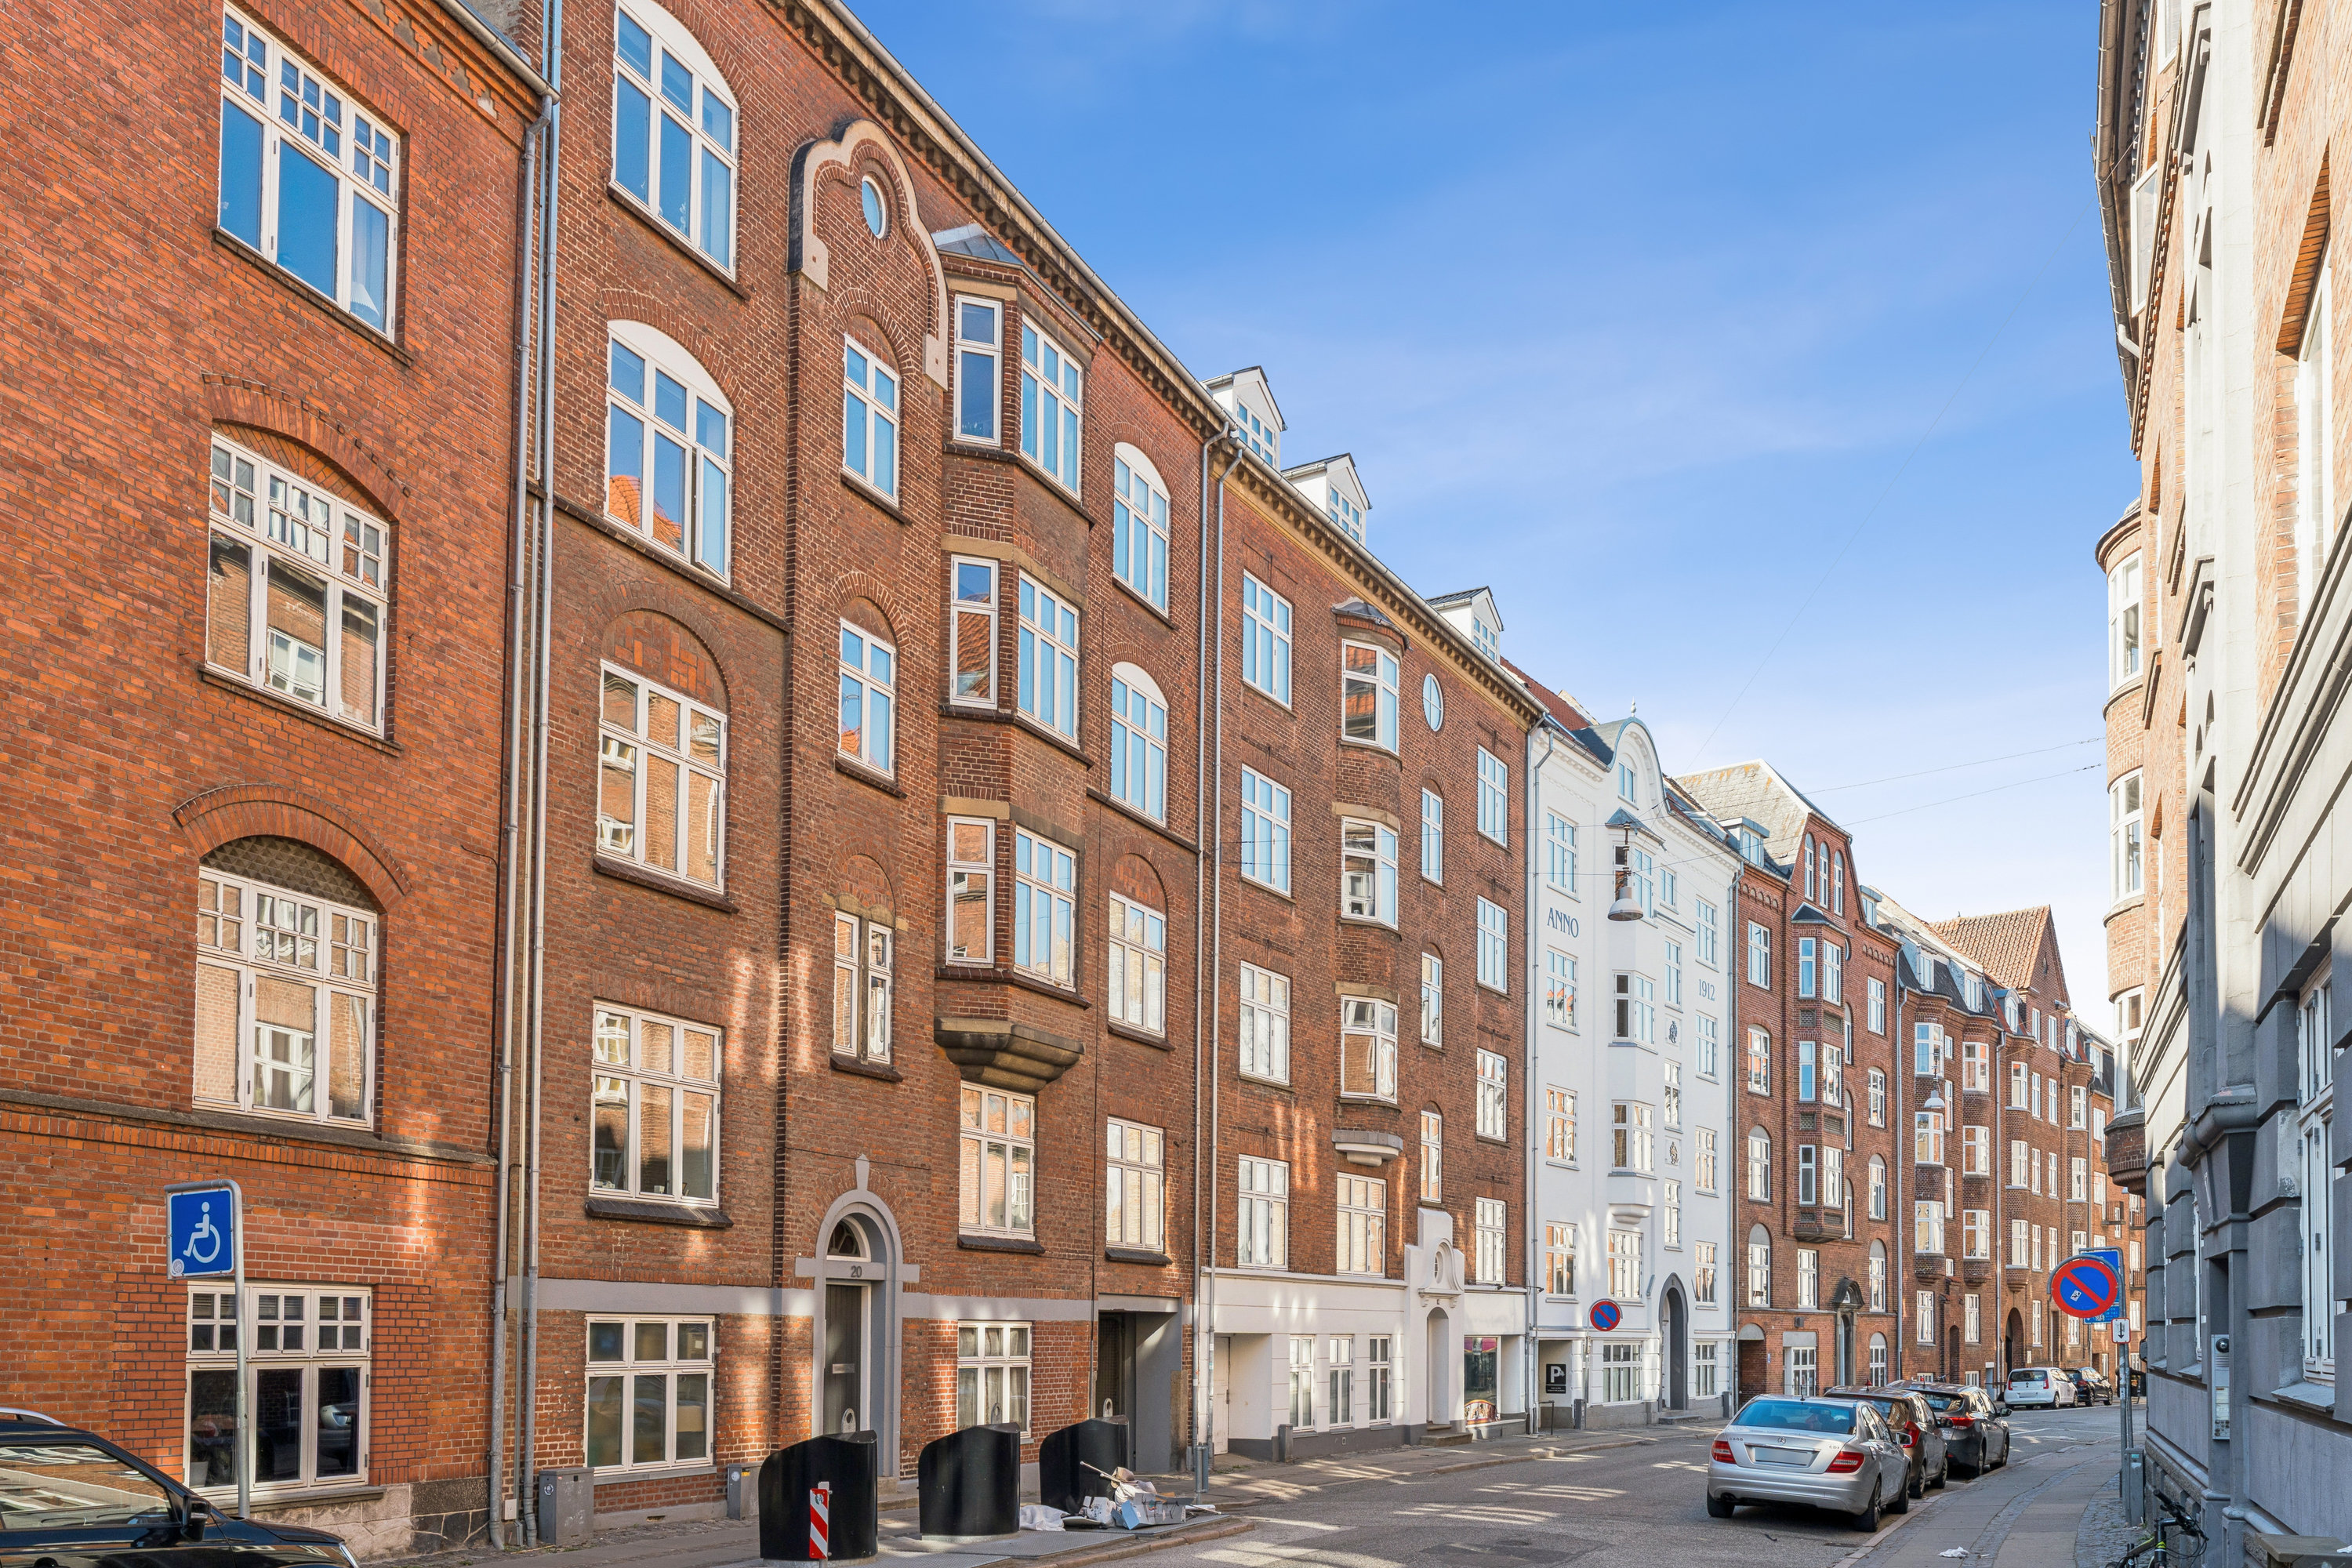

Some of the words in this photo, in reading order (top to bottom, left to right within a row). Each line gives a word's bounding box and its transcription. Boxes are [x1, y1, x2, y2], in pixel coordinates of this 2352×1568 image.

[1547, 907, 1579, 938] ANNO
[1699, 979, 1715, 1001] 1912
[851, 1265, 862, 1278] 20
[1550, 1366, 1562, 1383] P
